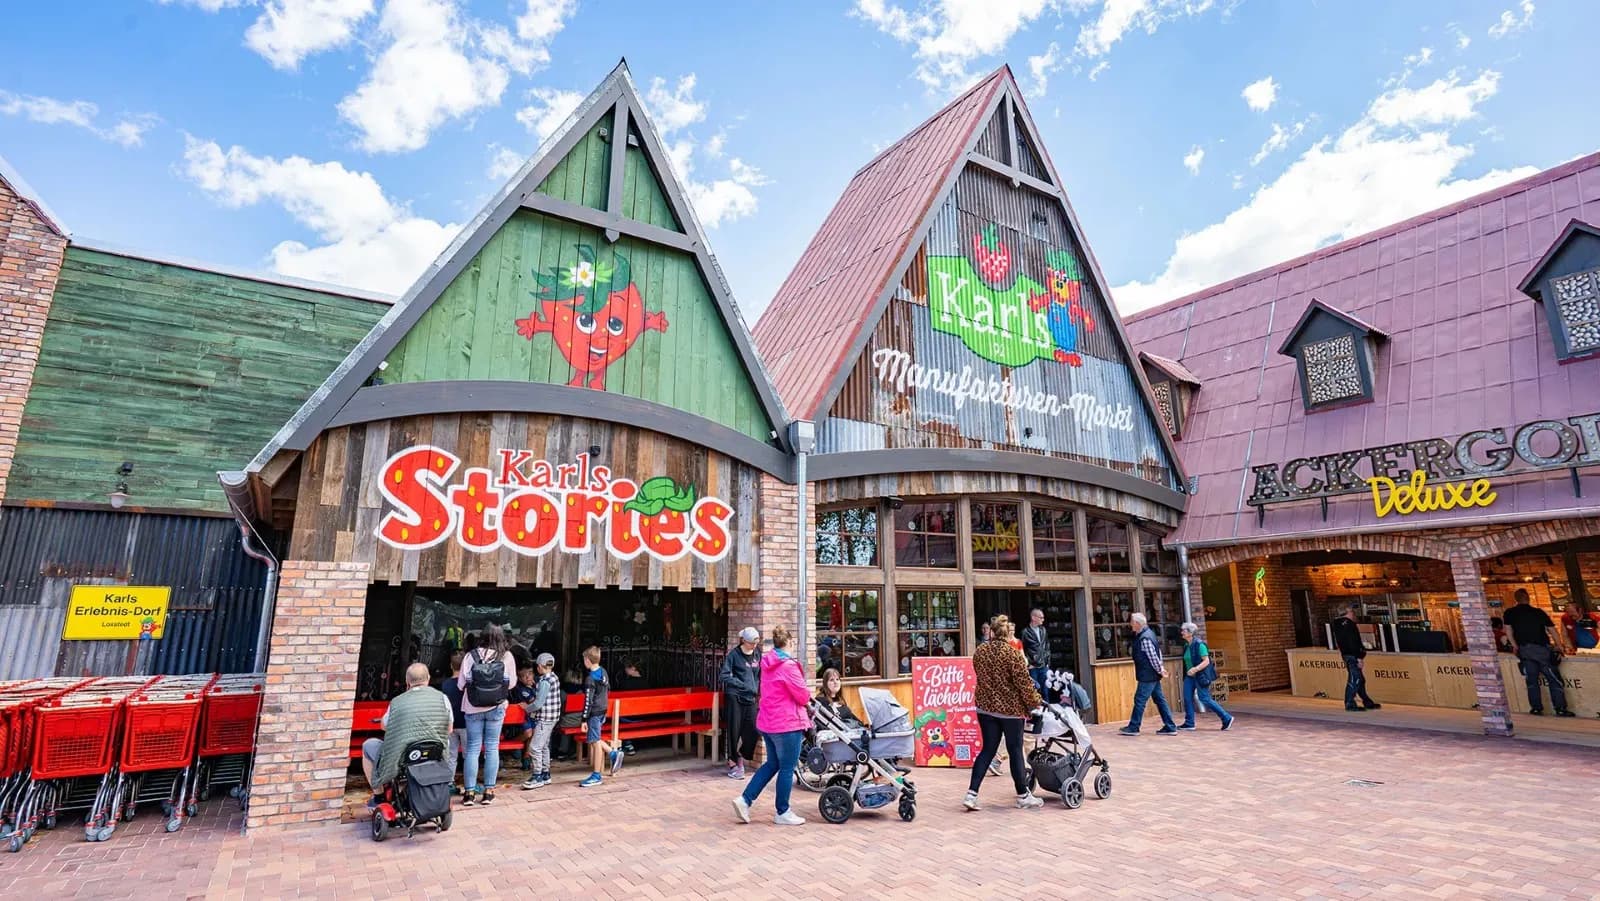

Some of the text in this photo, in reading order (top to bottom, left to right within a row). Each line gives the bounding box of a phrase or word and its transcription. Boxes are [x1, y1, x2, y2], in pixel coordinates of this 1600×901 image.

[936, 270, 1050, 349] Karls
[873, 349, 1133, 432] Manufakturen-Markt
[497, 450, 610, 493] Karls
[376, 446, 733, 560] Stories
[1366, 469, 1497, 518] Deluxe
[75, 606, 161, 616] Erlebnis-Dorf
[104, 594, 137, 603] Karls
[922, 664, 964, 687] Bitte
[1374, 669, 1410, 680] DELUXE
[1436, 665, 1474, 676] ACKER
[923, 682, 973, 707] lächeln
